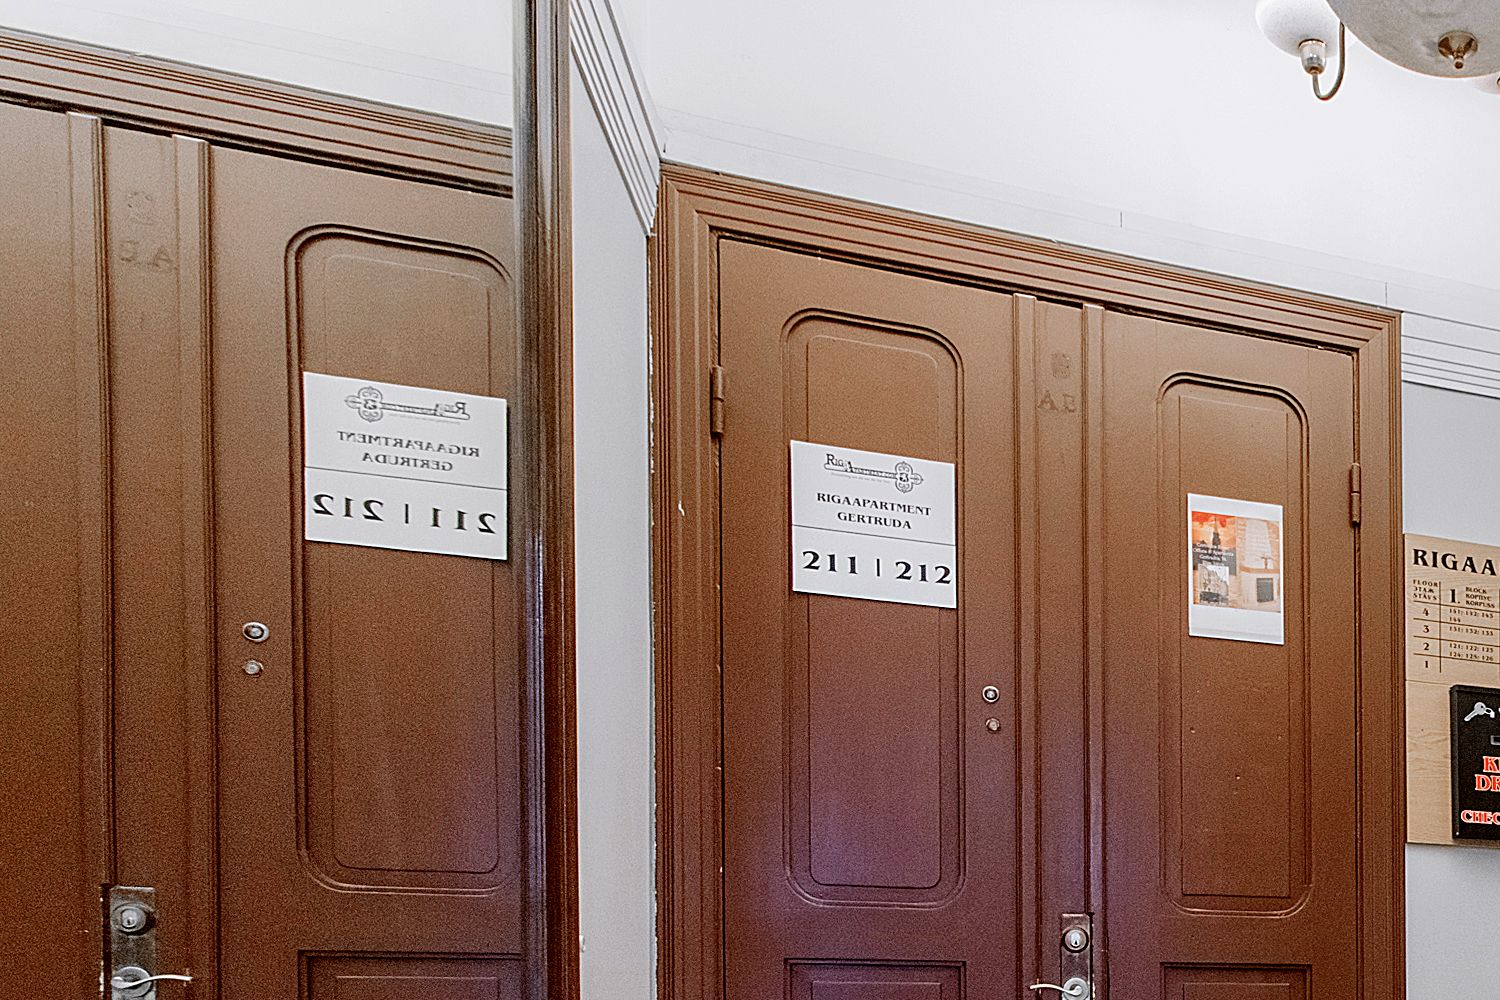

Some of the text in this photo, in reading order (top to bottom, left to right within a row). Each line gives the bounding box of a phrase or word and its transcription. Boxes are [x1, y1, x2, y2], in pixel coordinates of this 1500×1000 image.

[816, 492, 932, 516] RIGAAPARTMENT
[837, 512, 912, 530] GERTRUDA
[802, 550, 858, 574] 211
[895, 561, 952, 584] 212
[1450, 589, 1460, 603] 1.
[1422, 608, 1429, 616] 4
[1423, 625, 1430, 633] 3
[1423, 642, 1430, 651] 2
[1425, 660, 1429, 668] 1
